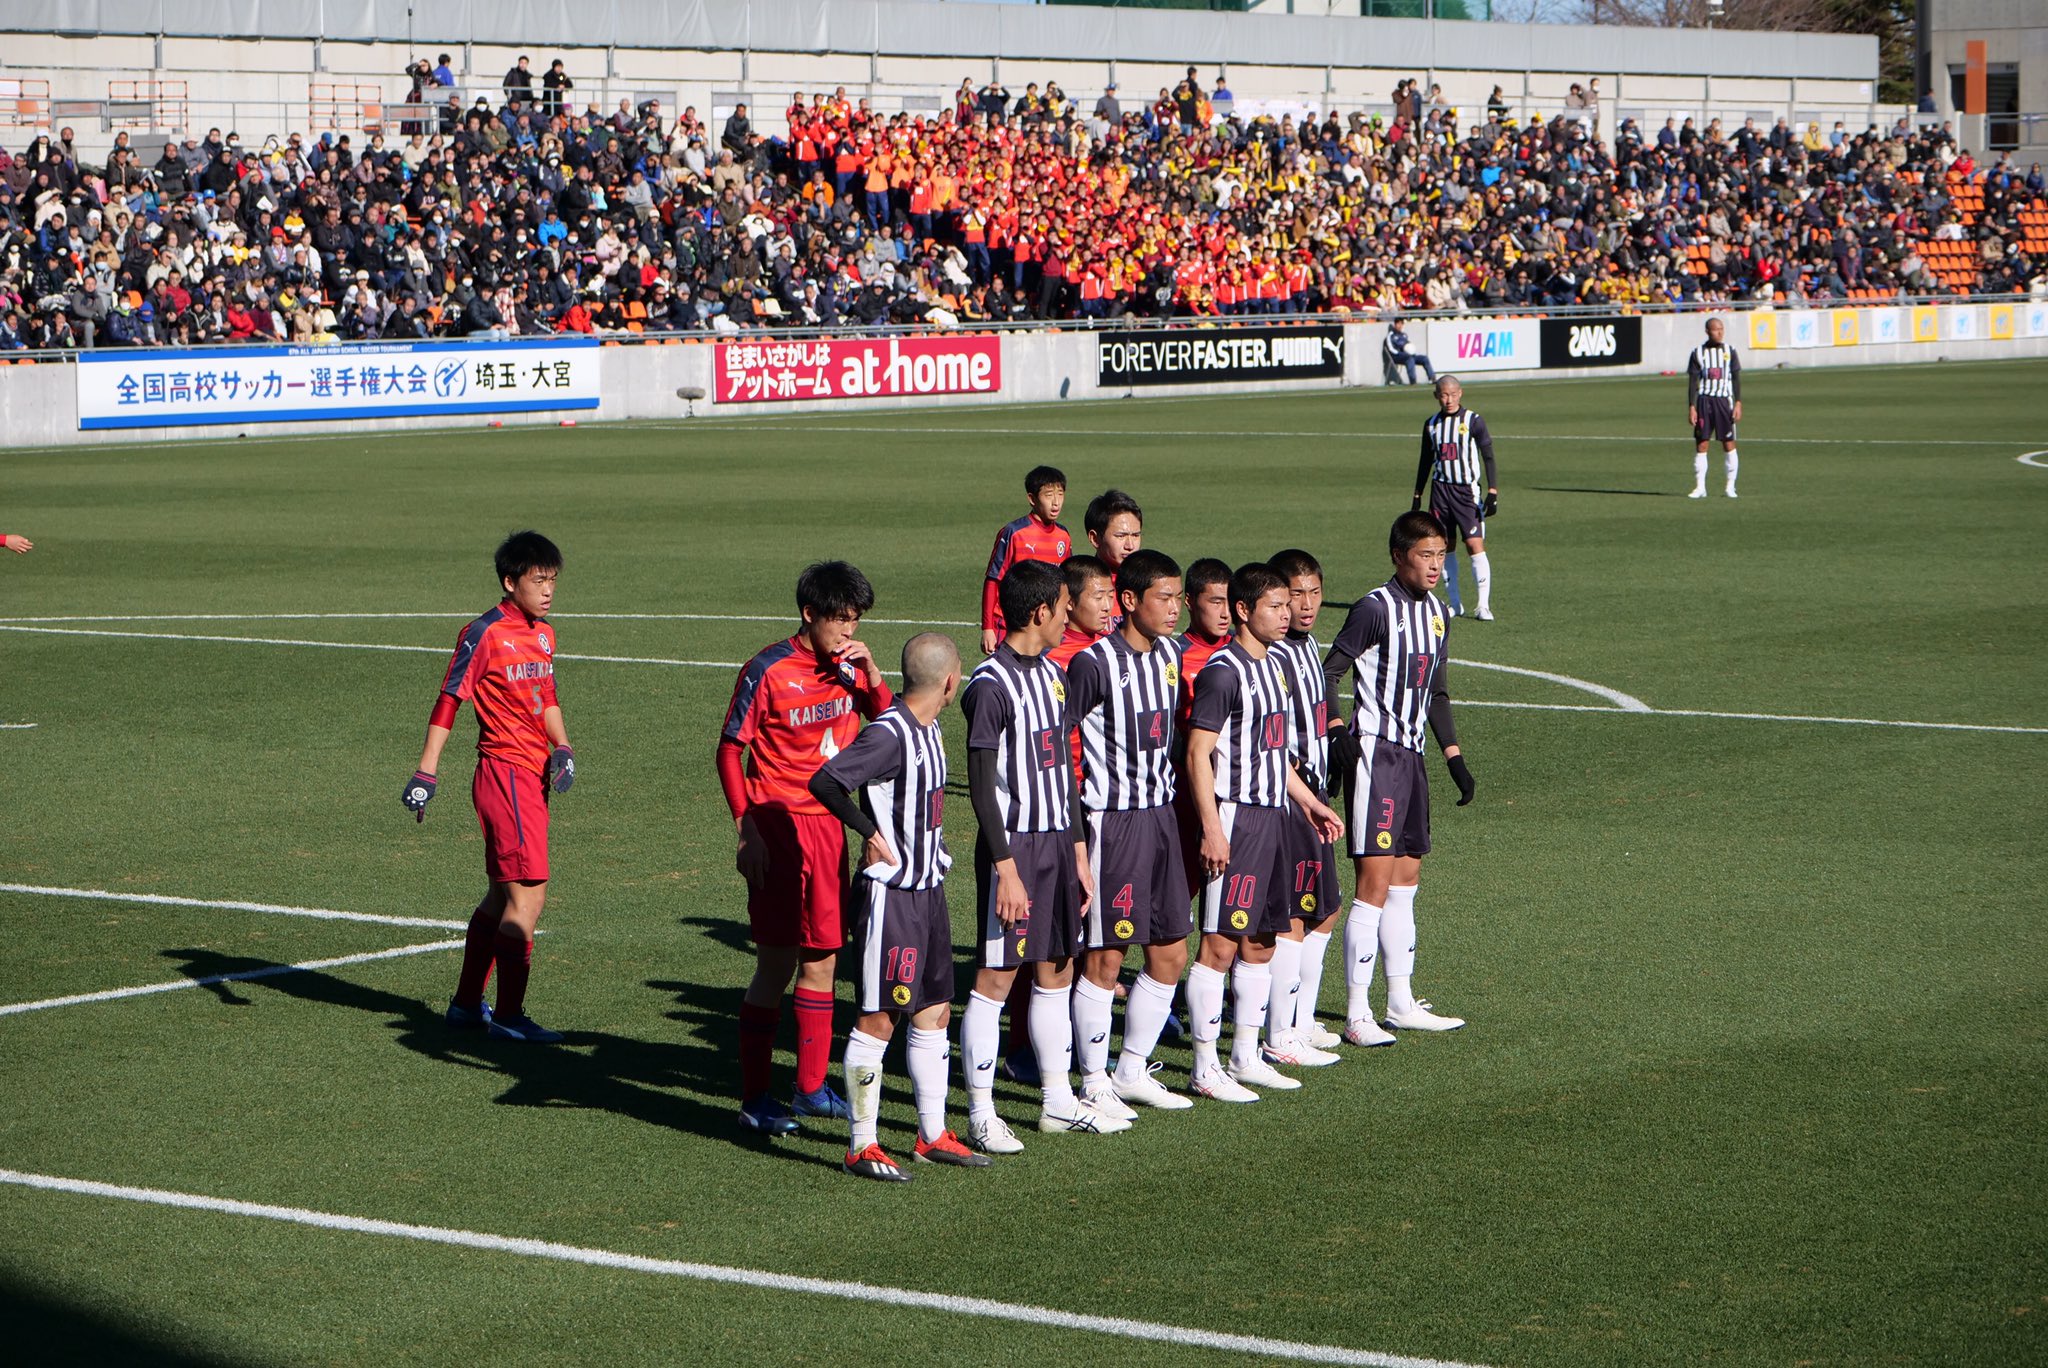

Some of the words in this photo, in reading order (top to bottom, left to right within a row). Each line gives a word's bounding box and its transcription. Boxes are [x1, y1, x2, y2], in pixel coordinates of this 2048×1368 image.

[725, 342, 832, 371] 住まいさがしは
[1099, 341, 1192, 374] FOREVER
[1193, 337, 1271, 370] FASTER.
[1271, 337, 1324, 367] PUMA
[1457, 331, 1514, 359] VAAM
[1568, 324, 1617, 358] SAVAS
[726, 367, 833, 400] アットホーム
[841, 348, 882, 395] at
[883, 339, 992, 394] home
[116, 364, 428, 406] 全国高校サッカー選手権大会
[1441, 443, 1458, 460] 20
[1416, 654, 1429, 687] 3
[533, 685, 543, 715] 5
[820, 726, 840, 760] 4
[1150, 711, 1162, 747] 4
[1265, 712, 1284, 749] 10
[1041, 729, 1056, 768] 5
[1376, 798, 1395, 830] 3
[1225, 873, 1257, 909] 10
[1294, 860, 1322, 892] 17
[1112, 883, 1134, 918] 4
[886, 945, 918, 984] 18
